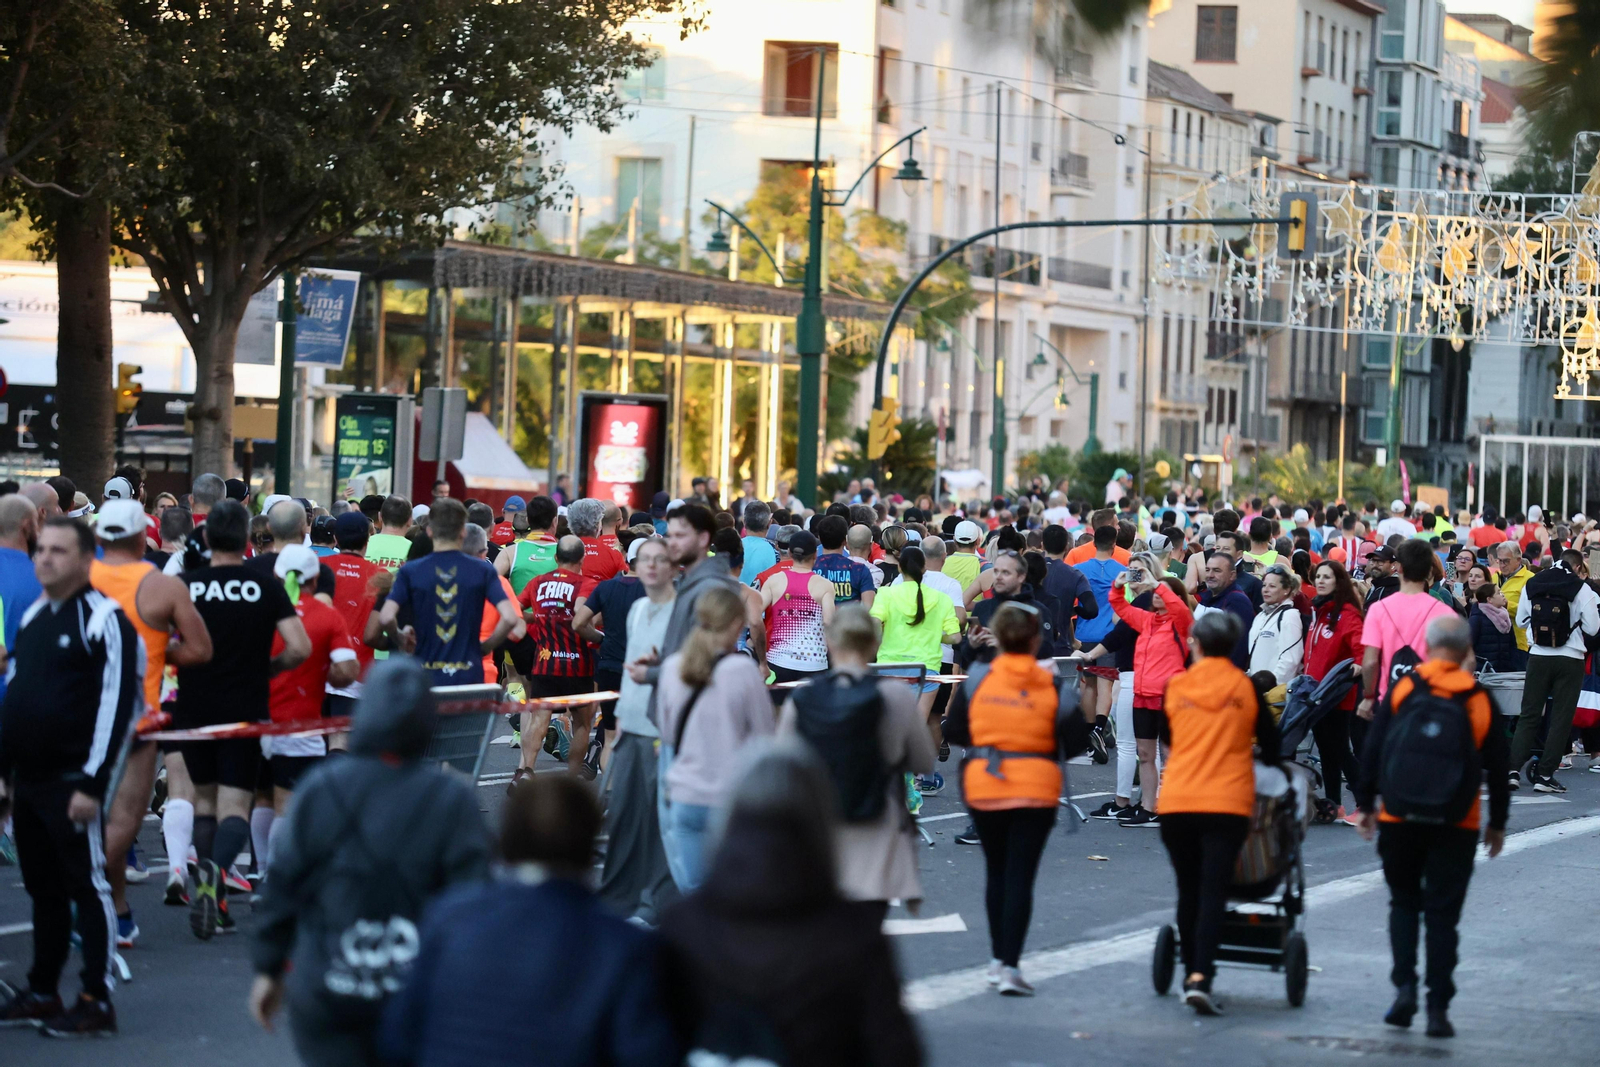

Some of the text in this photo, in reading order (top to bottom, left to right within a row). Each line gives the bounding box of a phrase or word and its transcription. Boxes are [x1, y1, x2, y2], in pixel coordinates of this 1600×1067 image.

[189, 579, 262, 604] PACO
[536, 580, 575, 603] CAIM
[552, 649, 580, 660] Málaga
